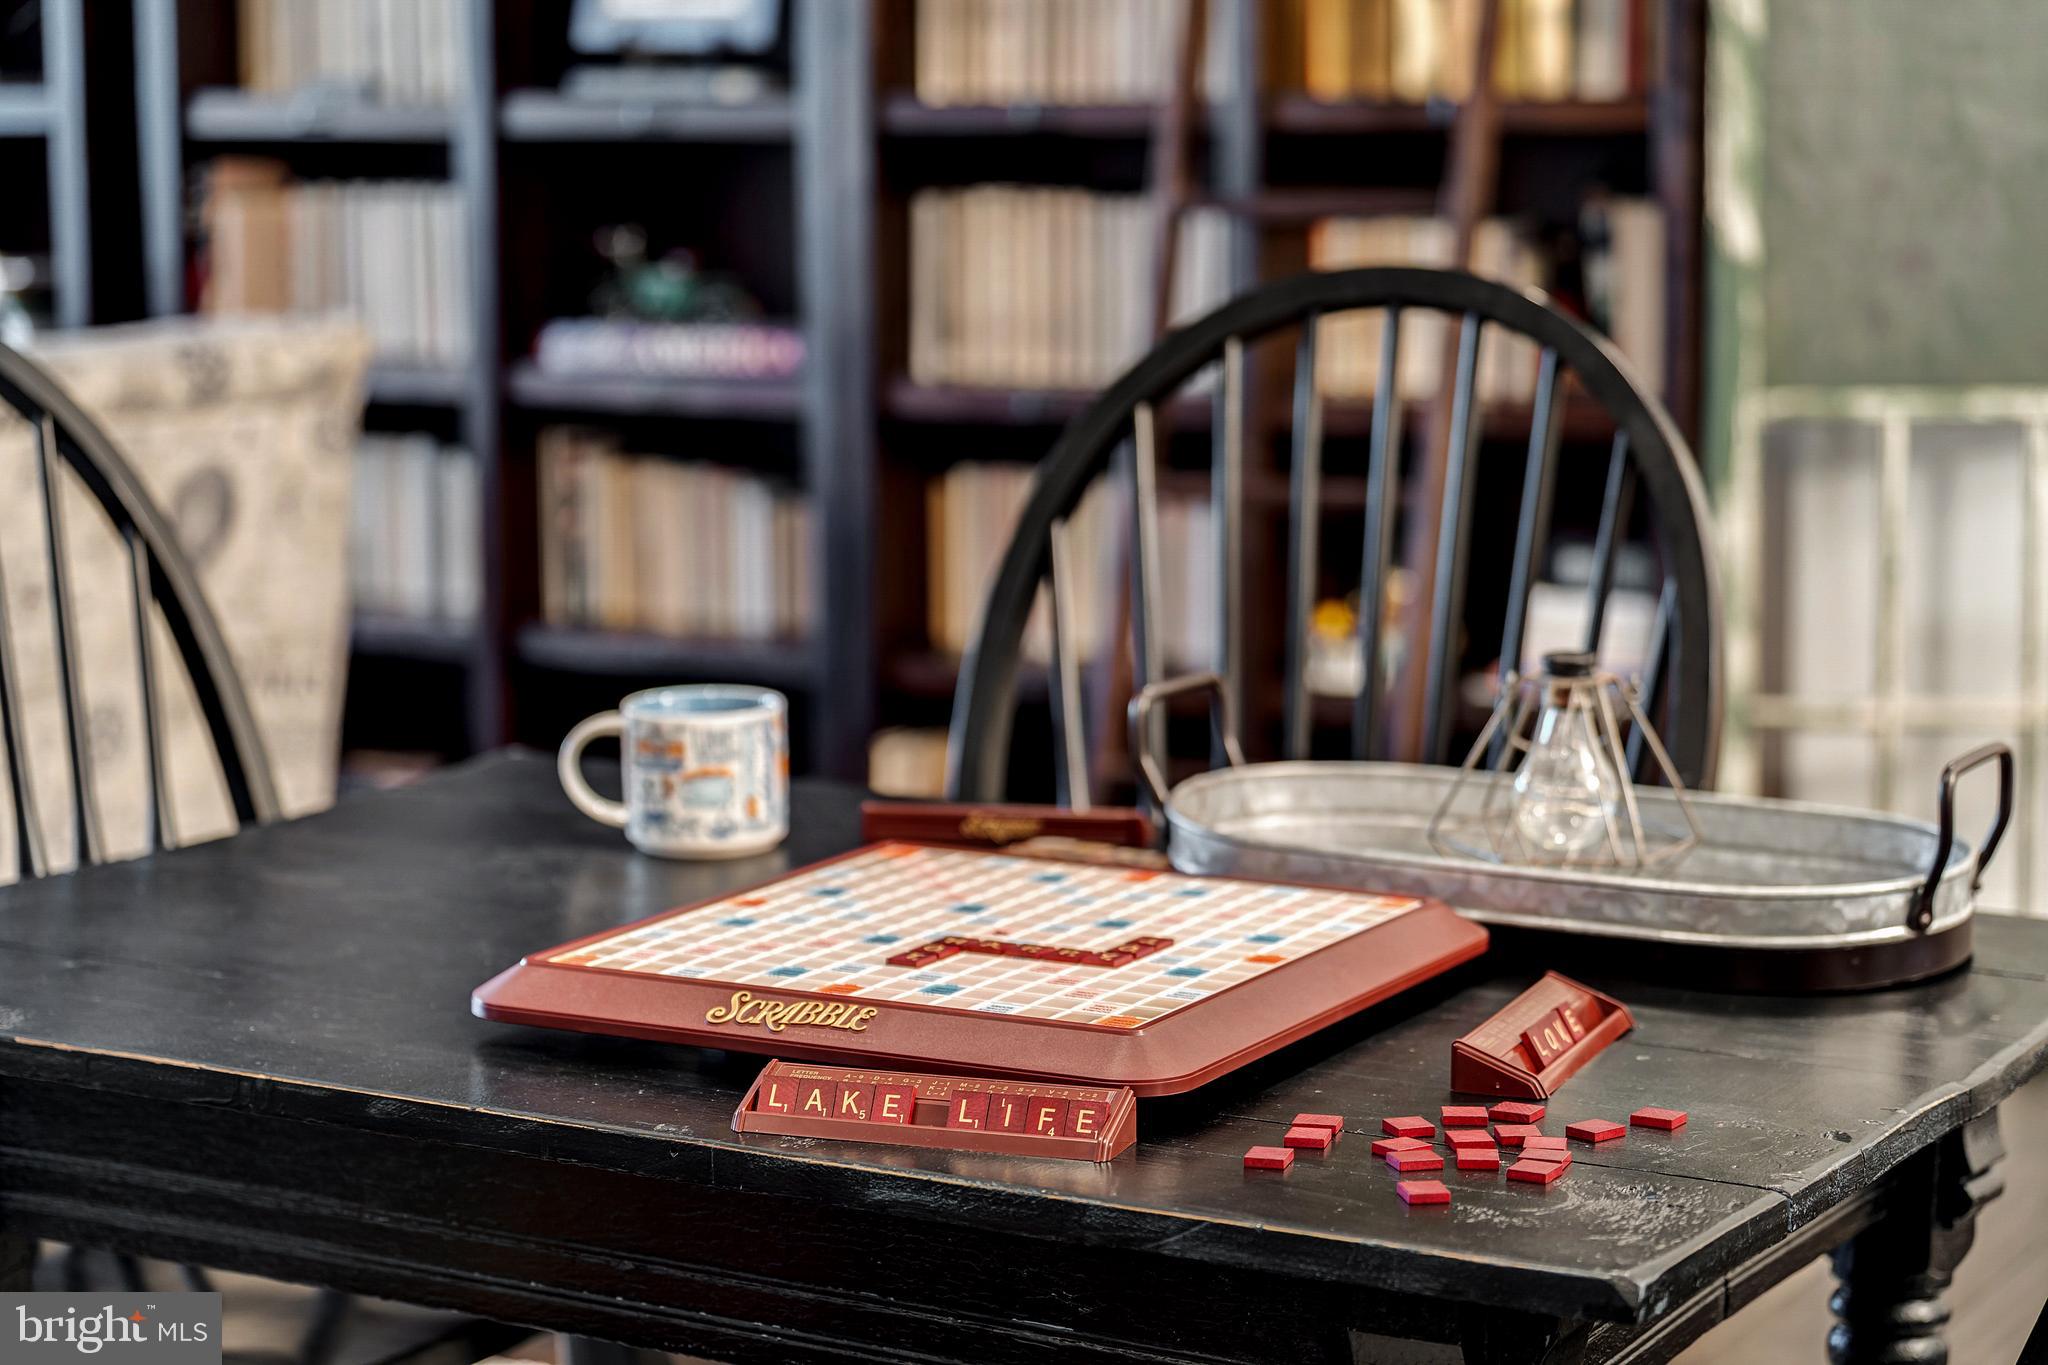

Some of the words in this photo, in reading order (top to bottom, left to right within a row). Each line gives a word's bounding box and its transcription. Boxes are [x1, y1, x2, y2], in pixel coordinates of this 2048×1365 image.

[705, 991, 878, 1031] SCRABBLE
[1533, 1009, 1582, 1056] LOVE
[768, 1084, 902, 1118] LAKE
[958, 1098, 1096, 1135] LIFE
